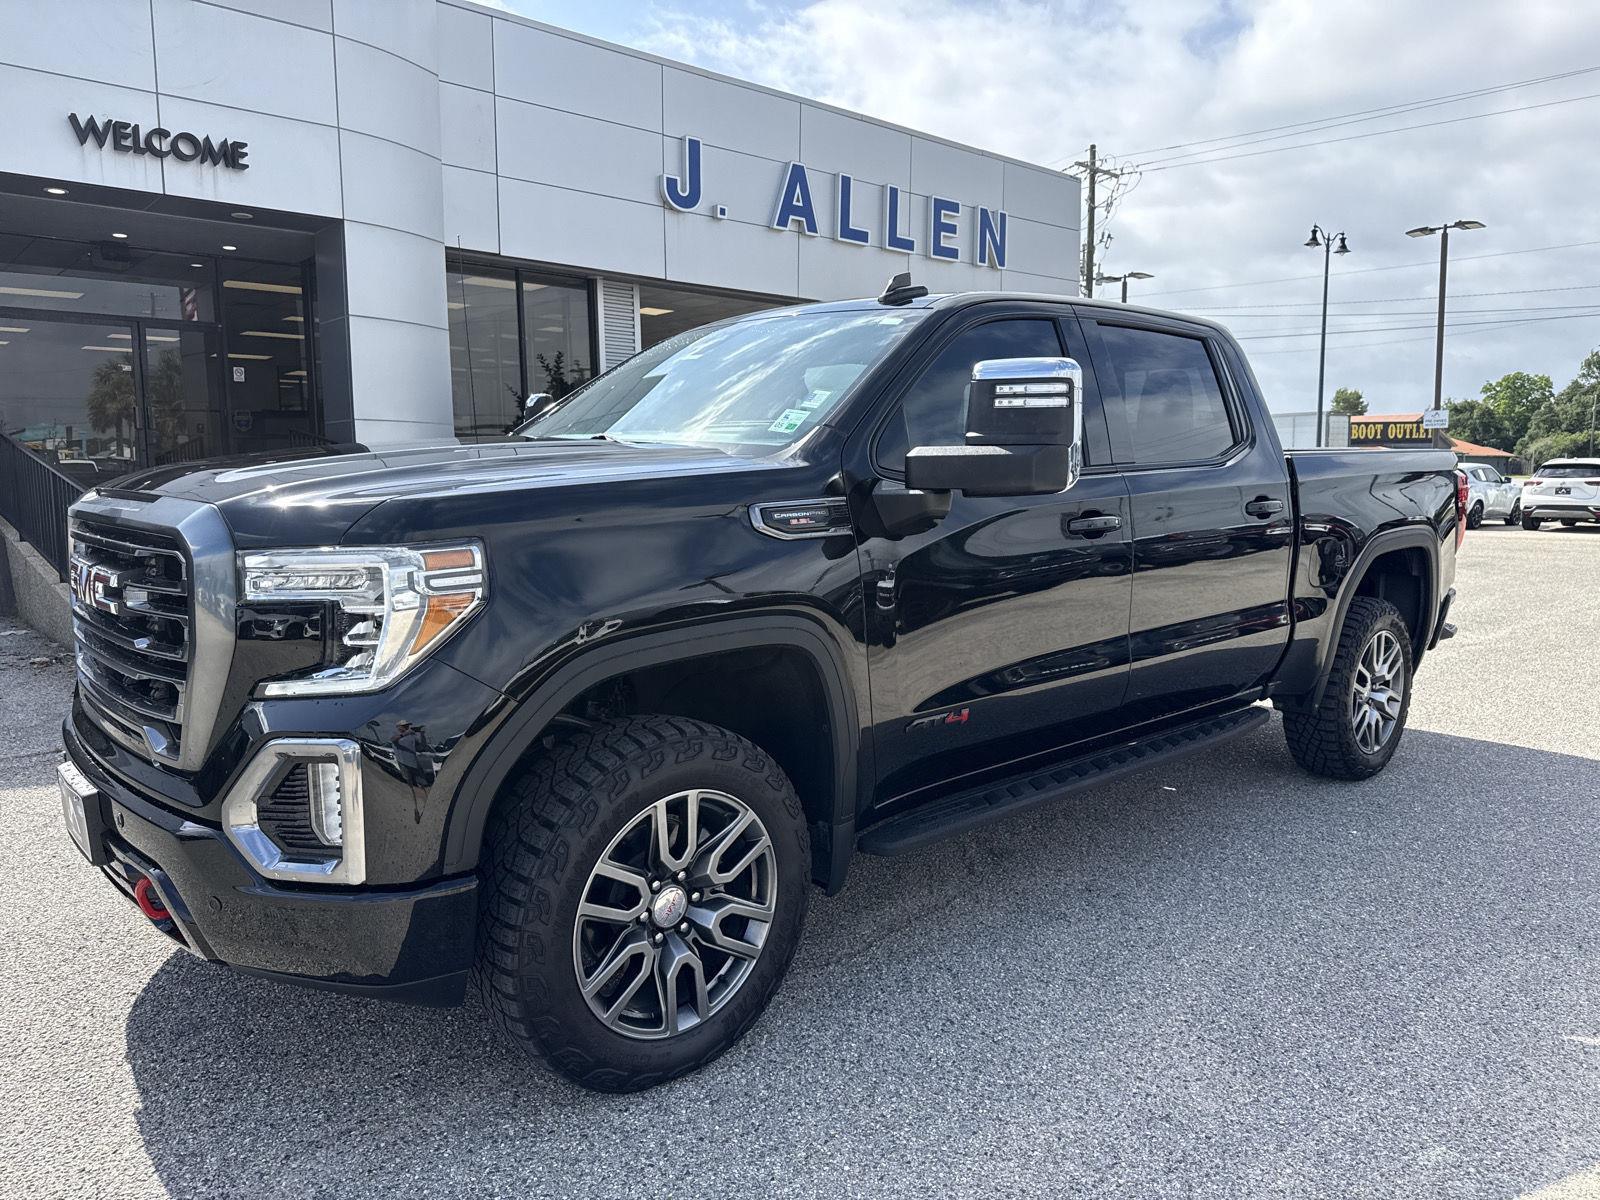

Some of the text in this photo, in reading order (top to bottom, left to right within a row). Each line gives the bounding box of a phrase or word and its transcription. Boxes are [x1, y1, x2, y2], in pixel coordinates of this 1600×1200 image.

[68, 113, 249, 170] WELCOME
[660, 135, 1008, 269] J. ALLEN
[1351, 424, 1383, 439] BOOT
